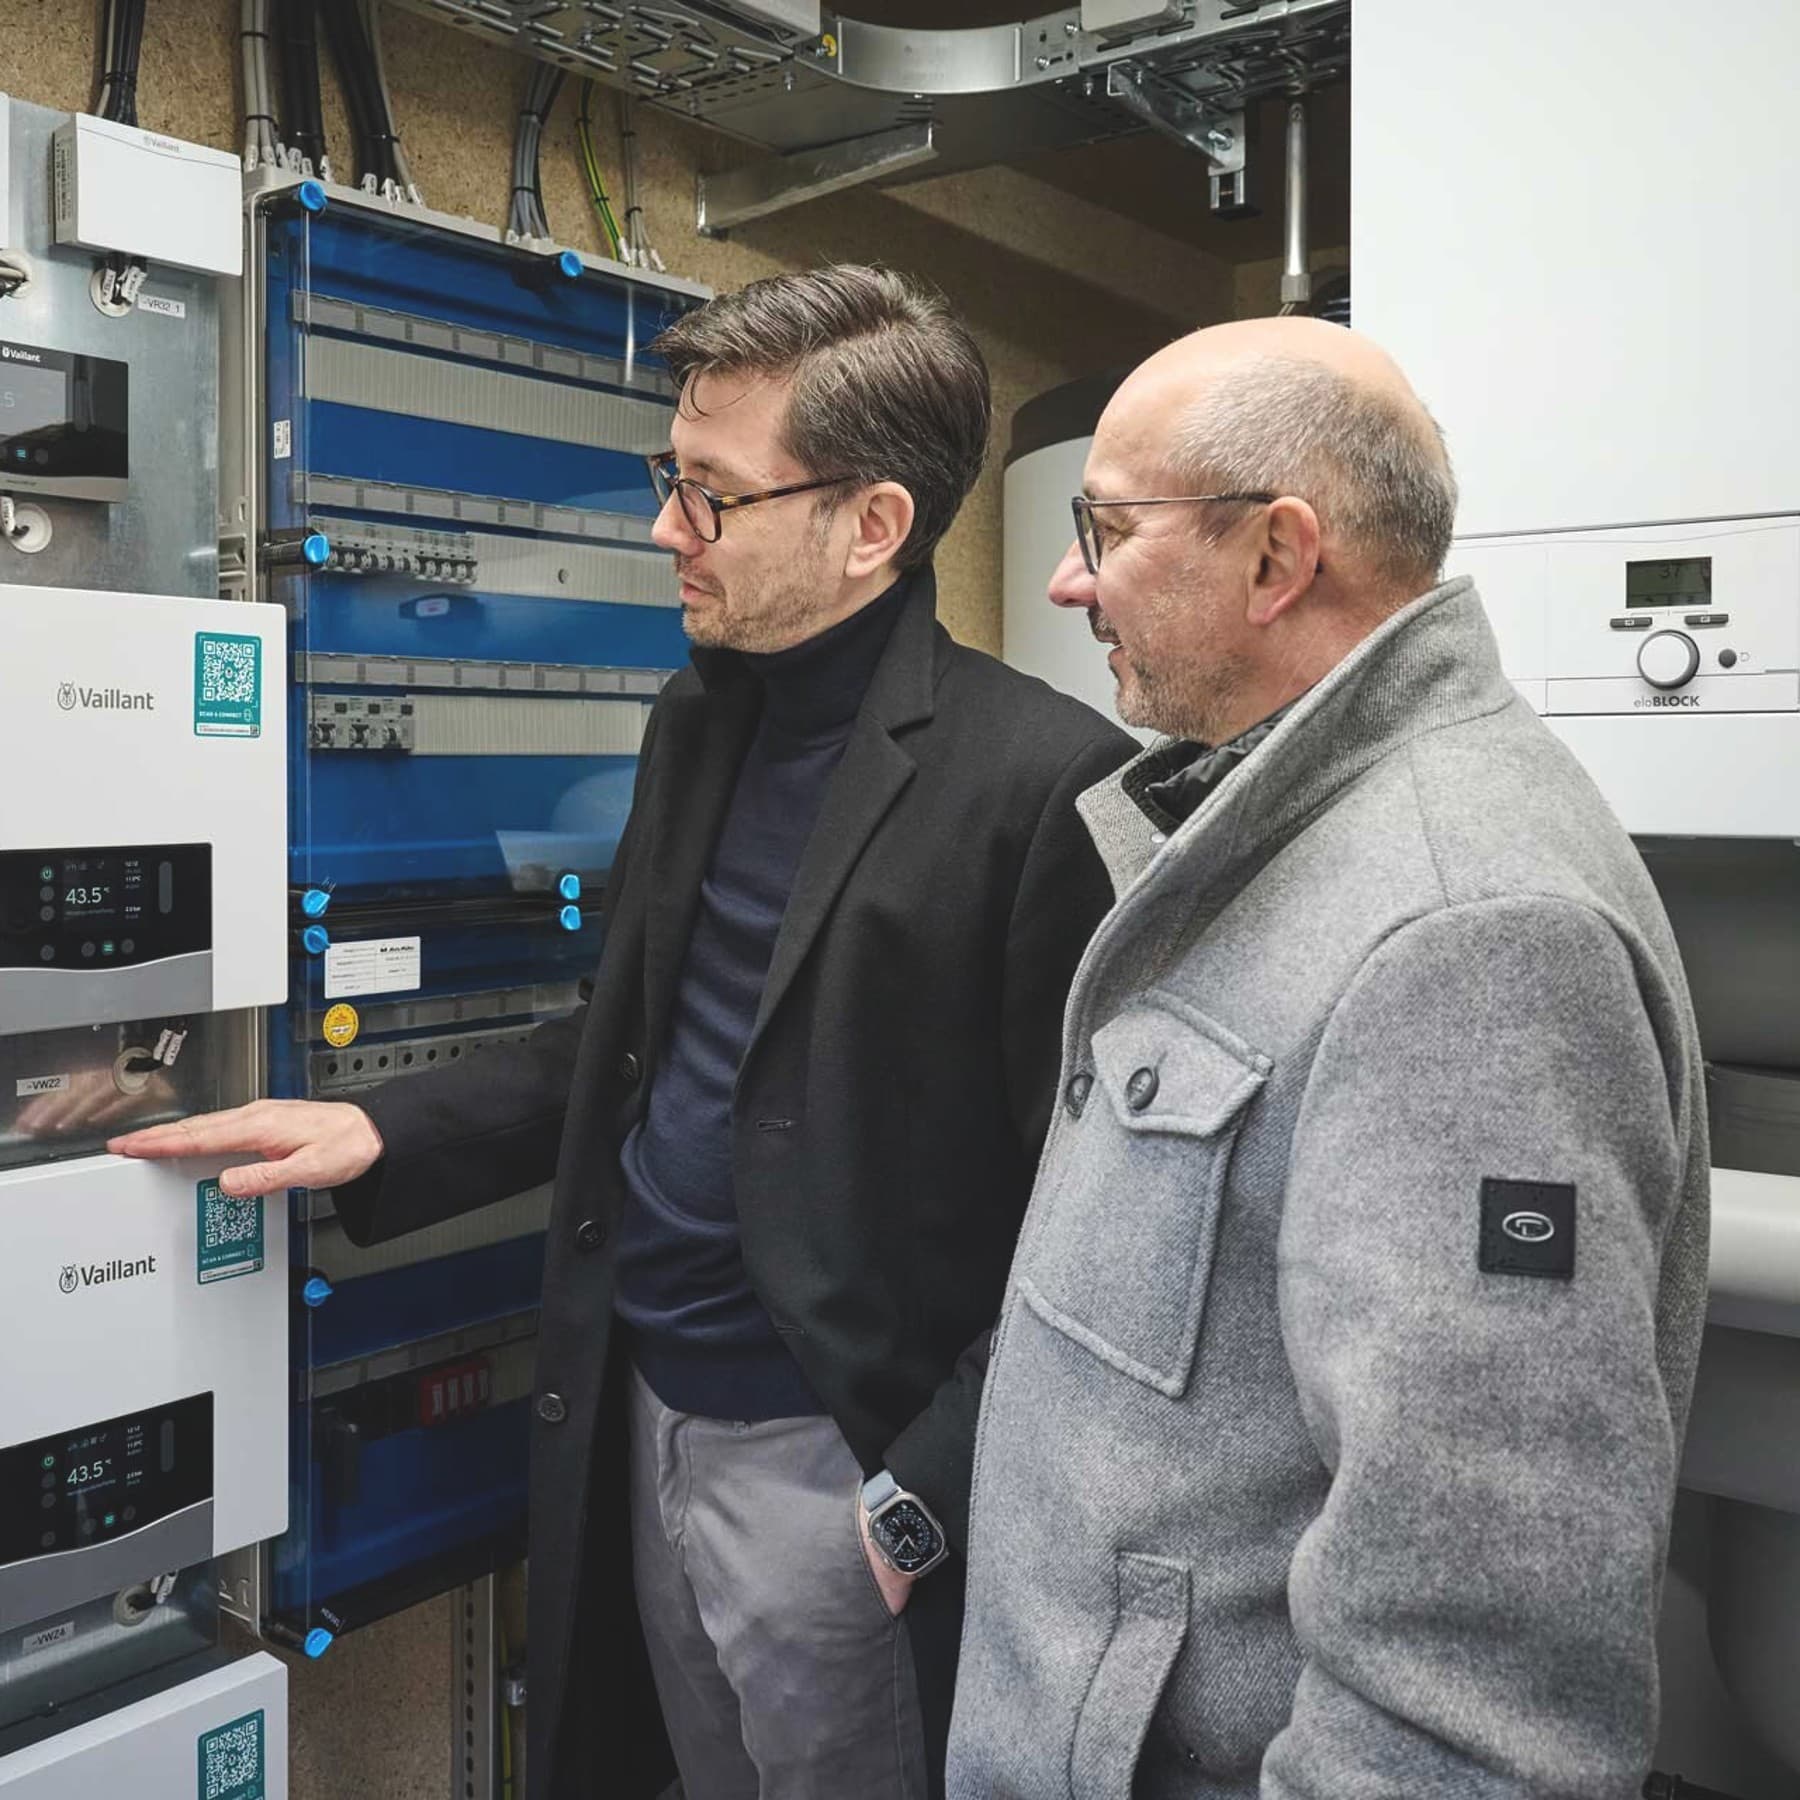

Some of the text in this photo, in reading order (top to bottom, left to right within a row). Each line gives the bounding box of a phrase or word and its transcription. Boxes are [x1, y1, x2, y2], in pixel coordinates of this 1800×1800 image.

[10, 349, 41, 362] Vaillant
[79, 687, 154, 711] Vaillant
[1634, 695, 1701, 708] eloBLOCK
[80, 1255, 156, 1286] Vaillant
